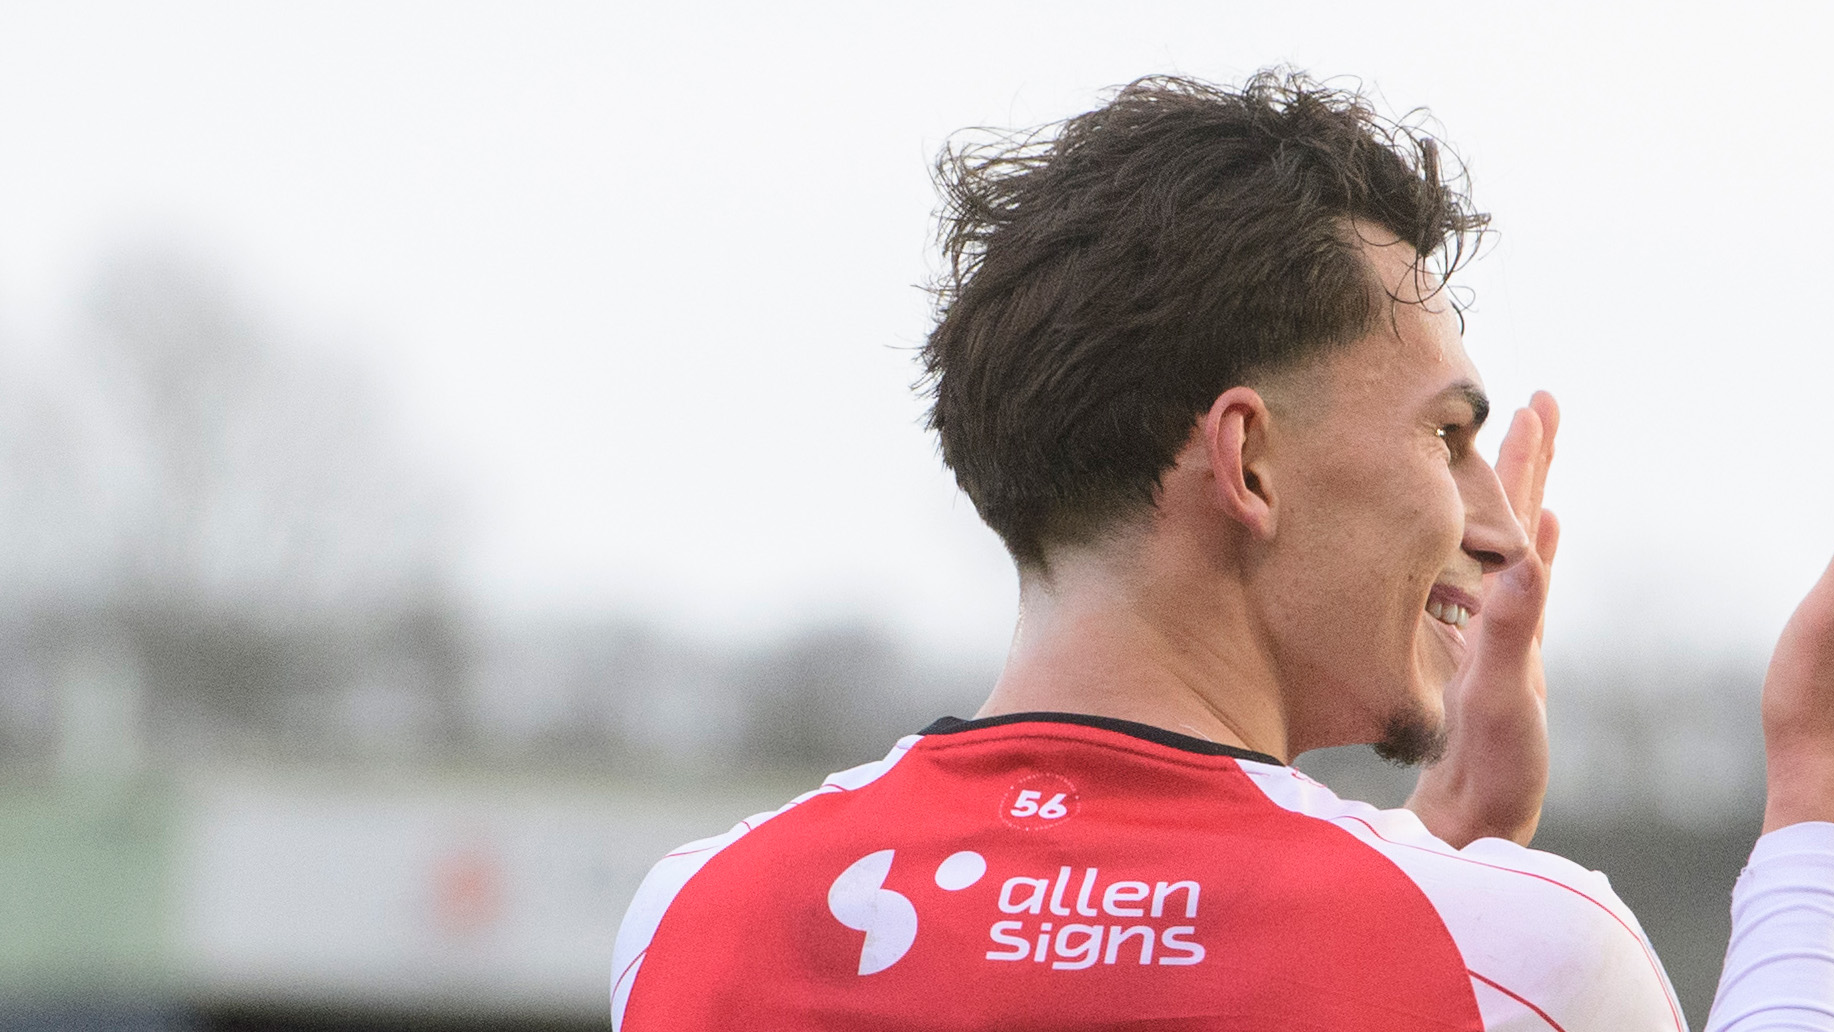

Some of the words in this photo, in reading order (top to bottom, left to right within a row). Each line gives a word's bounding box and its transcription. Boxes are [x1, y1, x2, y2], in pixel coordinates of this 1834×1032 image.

[1010, 789, 1067, 819] 56
[998, 866, 1201, 918] allen
[986, 920, 1206, 971] signs
